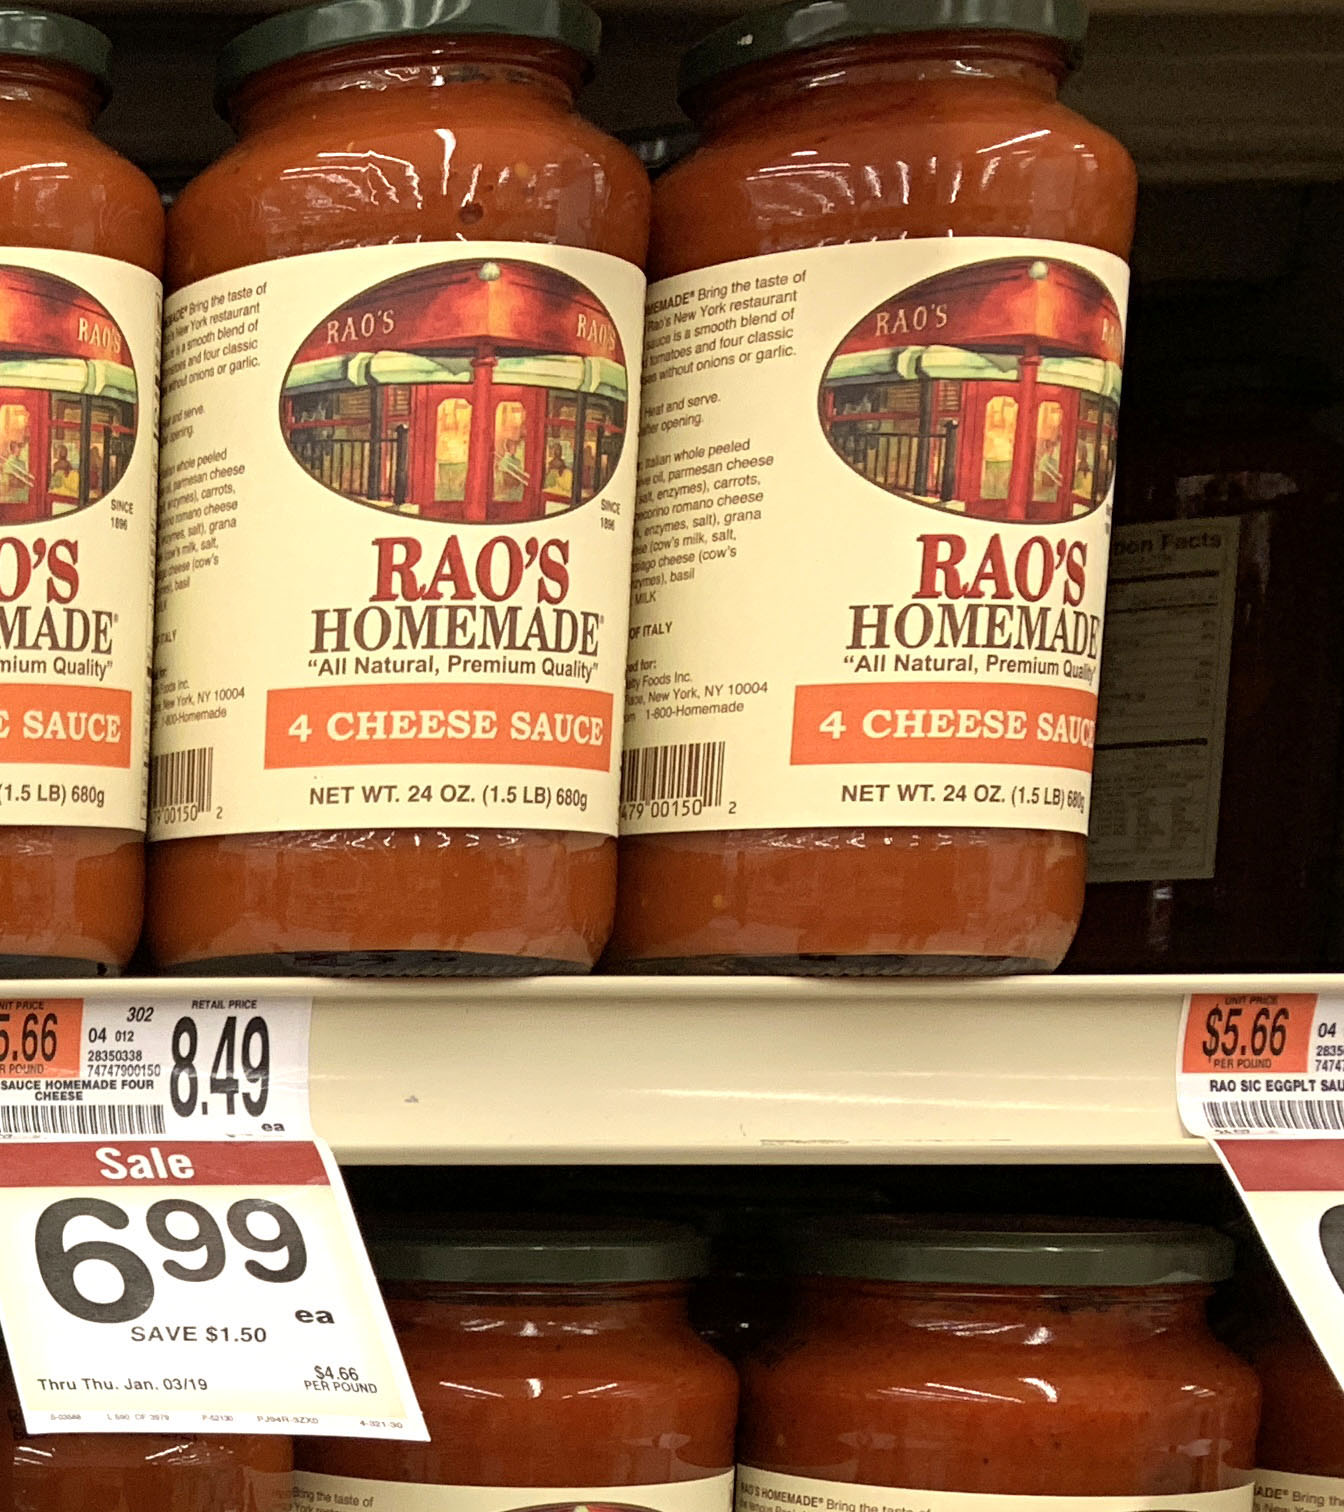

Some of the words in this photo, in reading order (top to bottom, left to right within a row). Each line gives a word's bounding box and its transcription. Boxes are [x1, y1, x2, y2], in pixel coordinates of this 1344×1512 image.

[369, 535, 569, 606] RAO'S
[912, 533, 1088, 607] RAO'S
[309, 605, 600, 656] HOMEMADE
[846, 603, 1100, 659] HOMEMADE
[22, 710, 121, 743] SAUCE
[0, 1081, 42, 1090] SAUCE
[45, 1080, 116, 1090] HOMEMADE
[120, 1080, 154, 1090] FOUR
[169, 1015, 270, 1117] 8.49
[1209, 1080, 1236, 1092] RAO
[1240, 1080, 1261, 1092] SIC
[1266, 1080, 1317, 1092] EGGPLT
[34, 1091, 83, 1101] CHEESE
[131, 1327, 197, 1342] SAVE
[205, 1327, 266, 1343] $1.50
